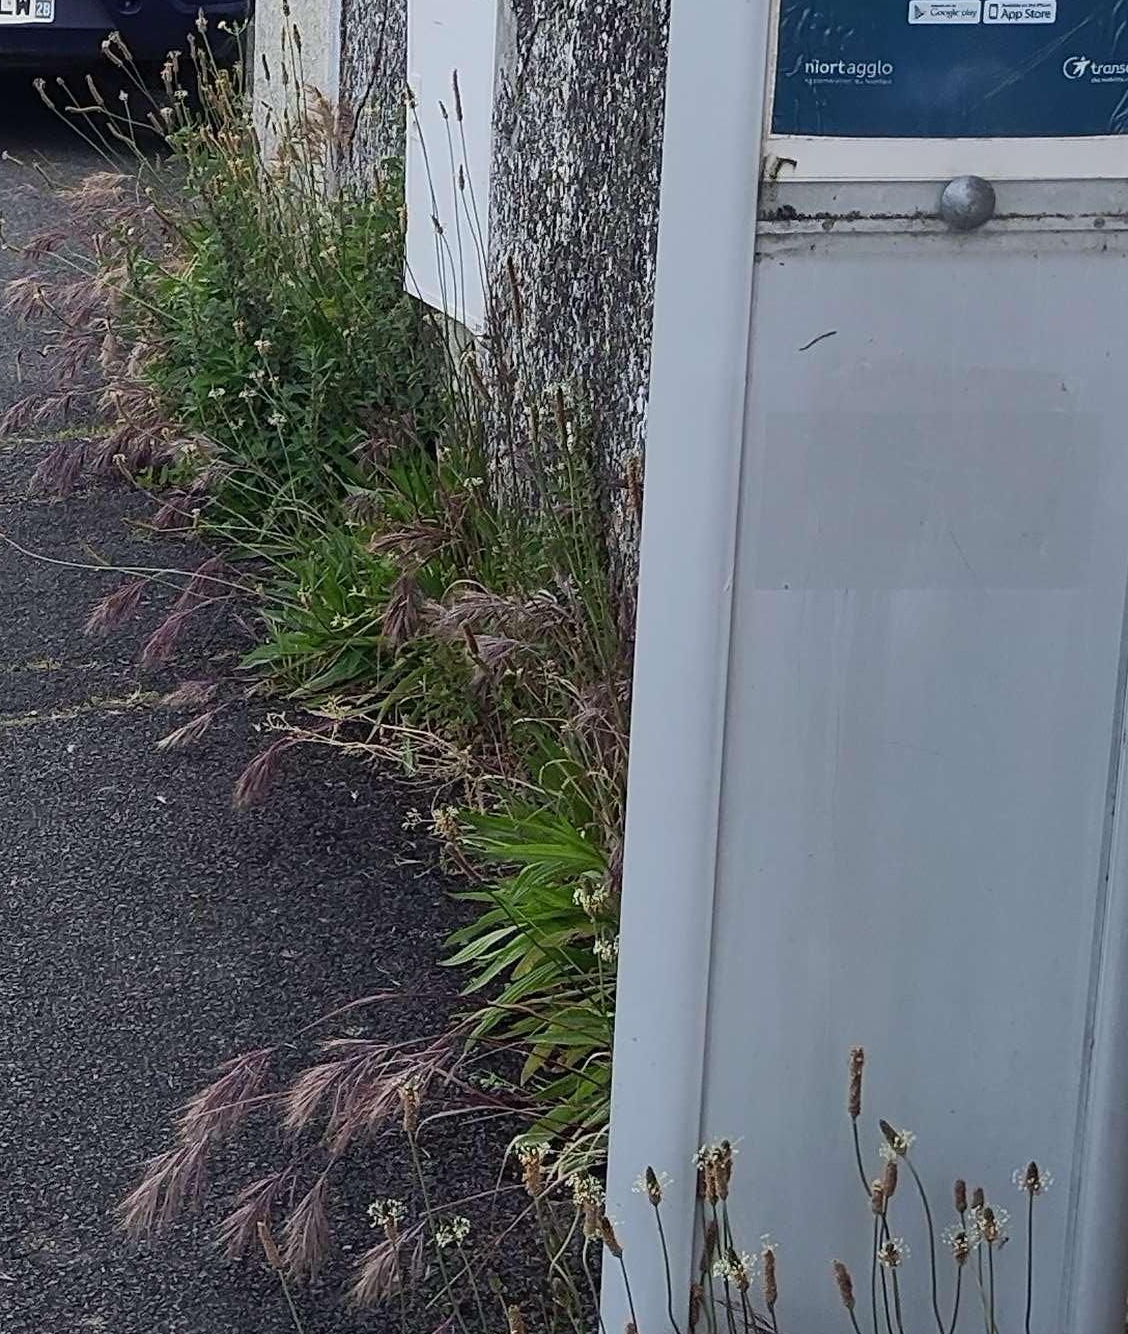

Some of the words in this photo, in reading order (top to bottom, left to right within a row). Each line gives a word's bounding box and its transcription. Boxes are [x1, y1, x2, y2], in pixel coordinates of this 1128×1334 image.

[35, 2, 52, 17] 2B
[930, 7, 960, 19] Google
[1000, 8, 1023, 21] App
[1024, 8, 1052, 20] Store
